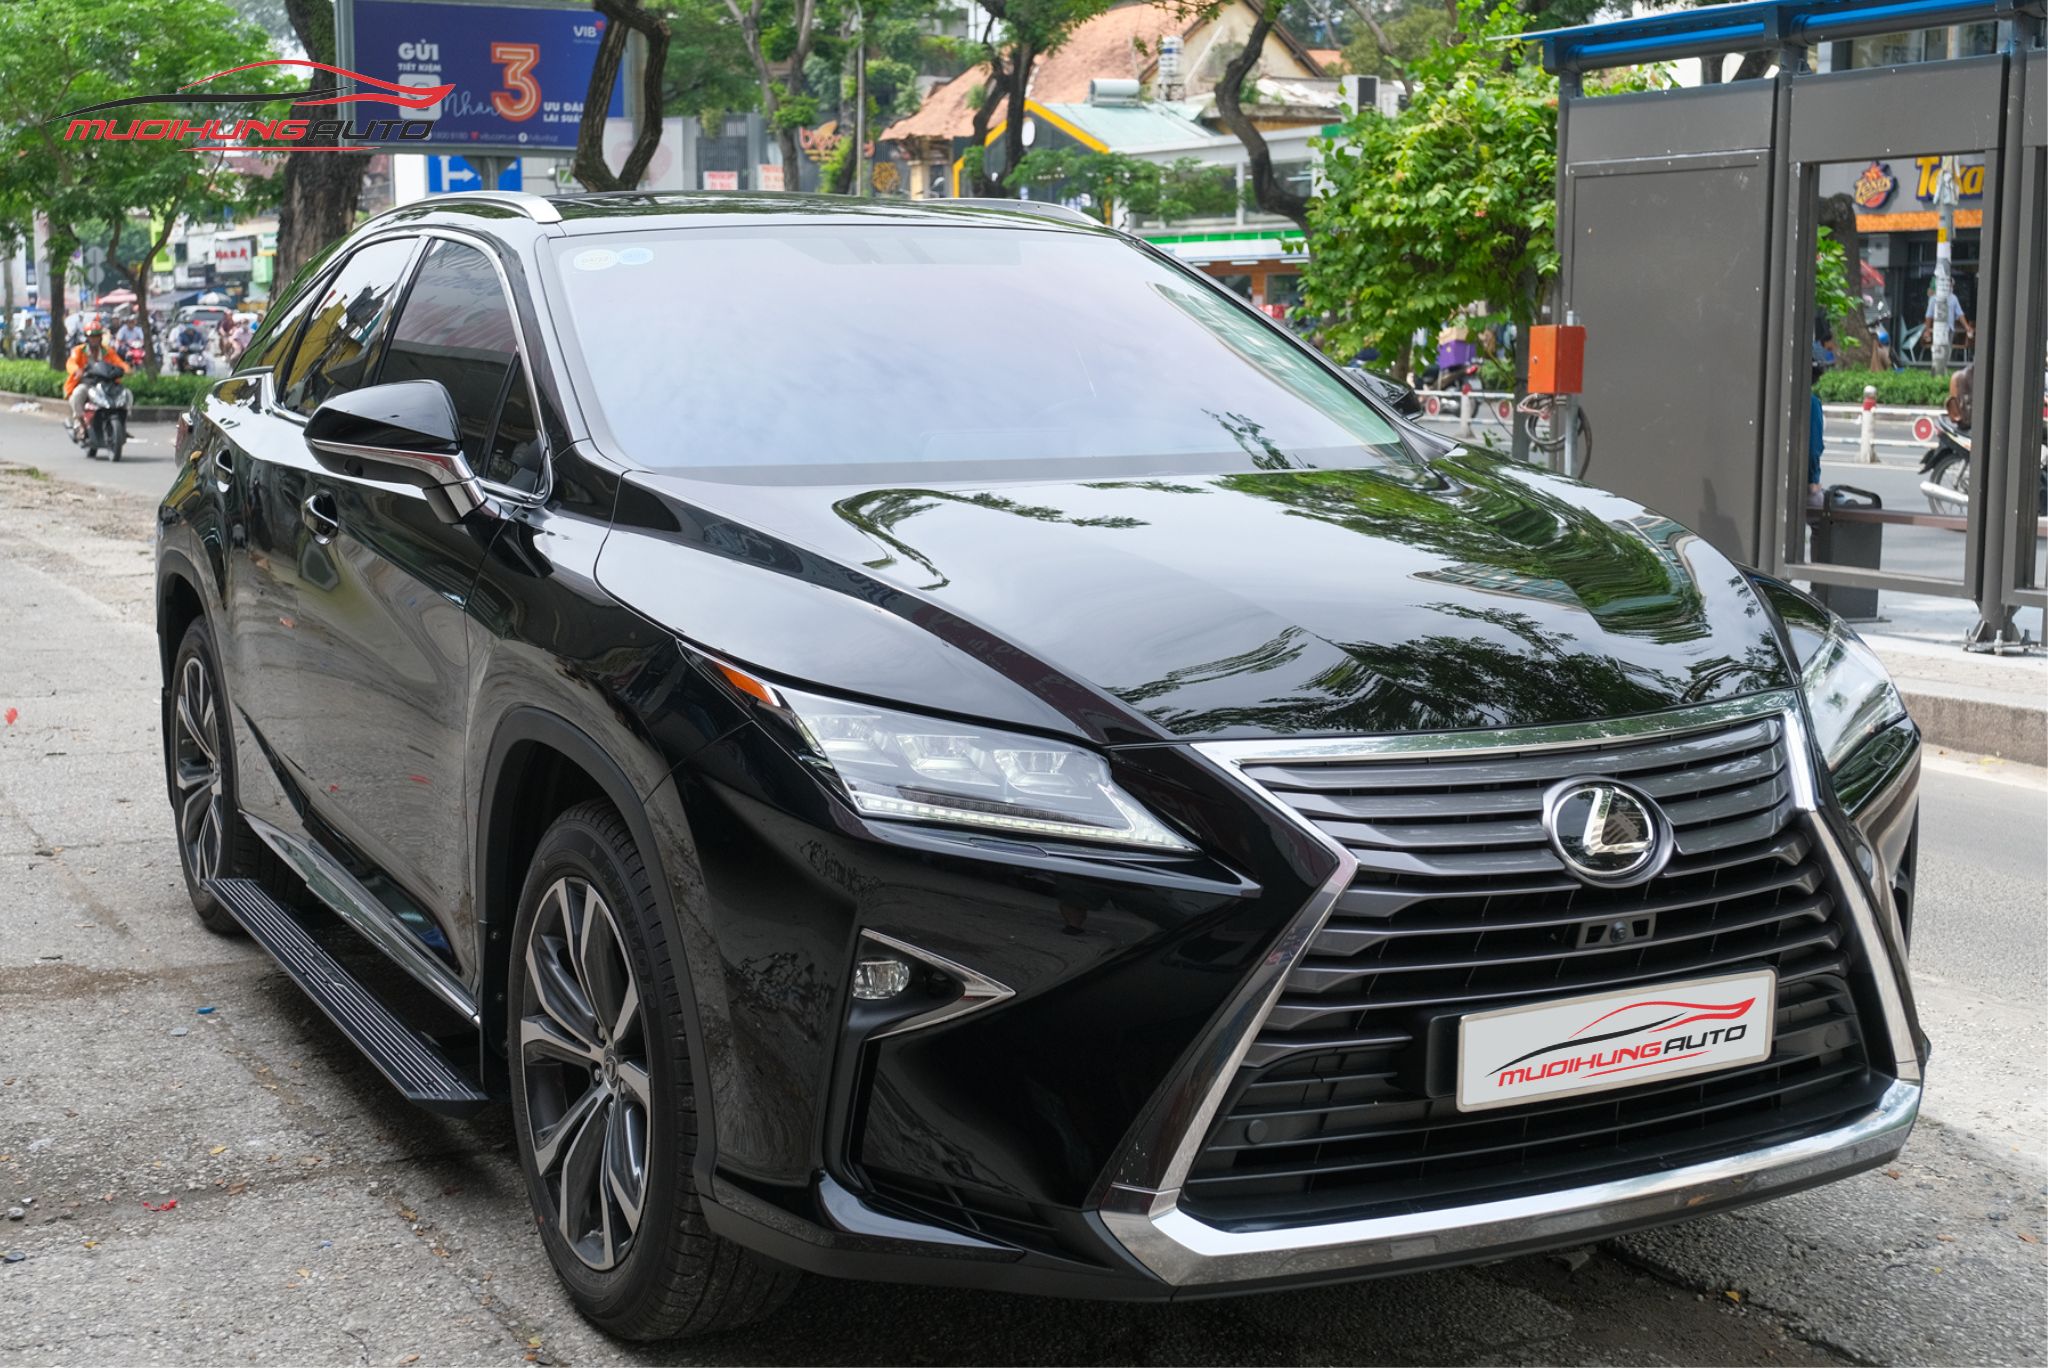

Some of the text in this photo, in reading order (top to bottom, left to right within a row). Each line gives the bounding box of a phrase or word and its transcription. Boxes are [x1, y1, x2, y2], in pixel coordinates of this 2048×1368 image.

[573, 25, 597, 38] VIB
[398, 38, 439, 61] GỬI
[491, 42, 542, 122] 3
